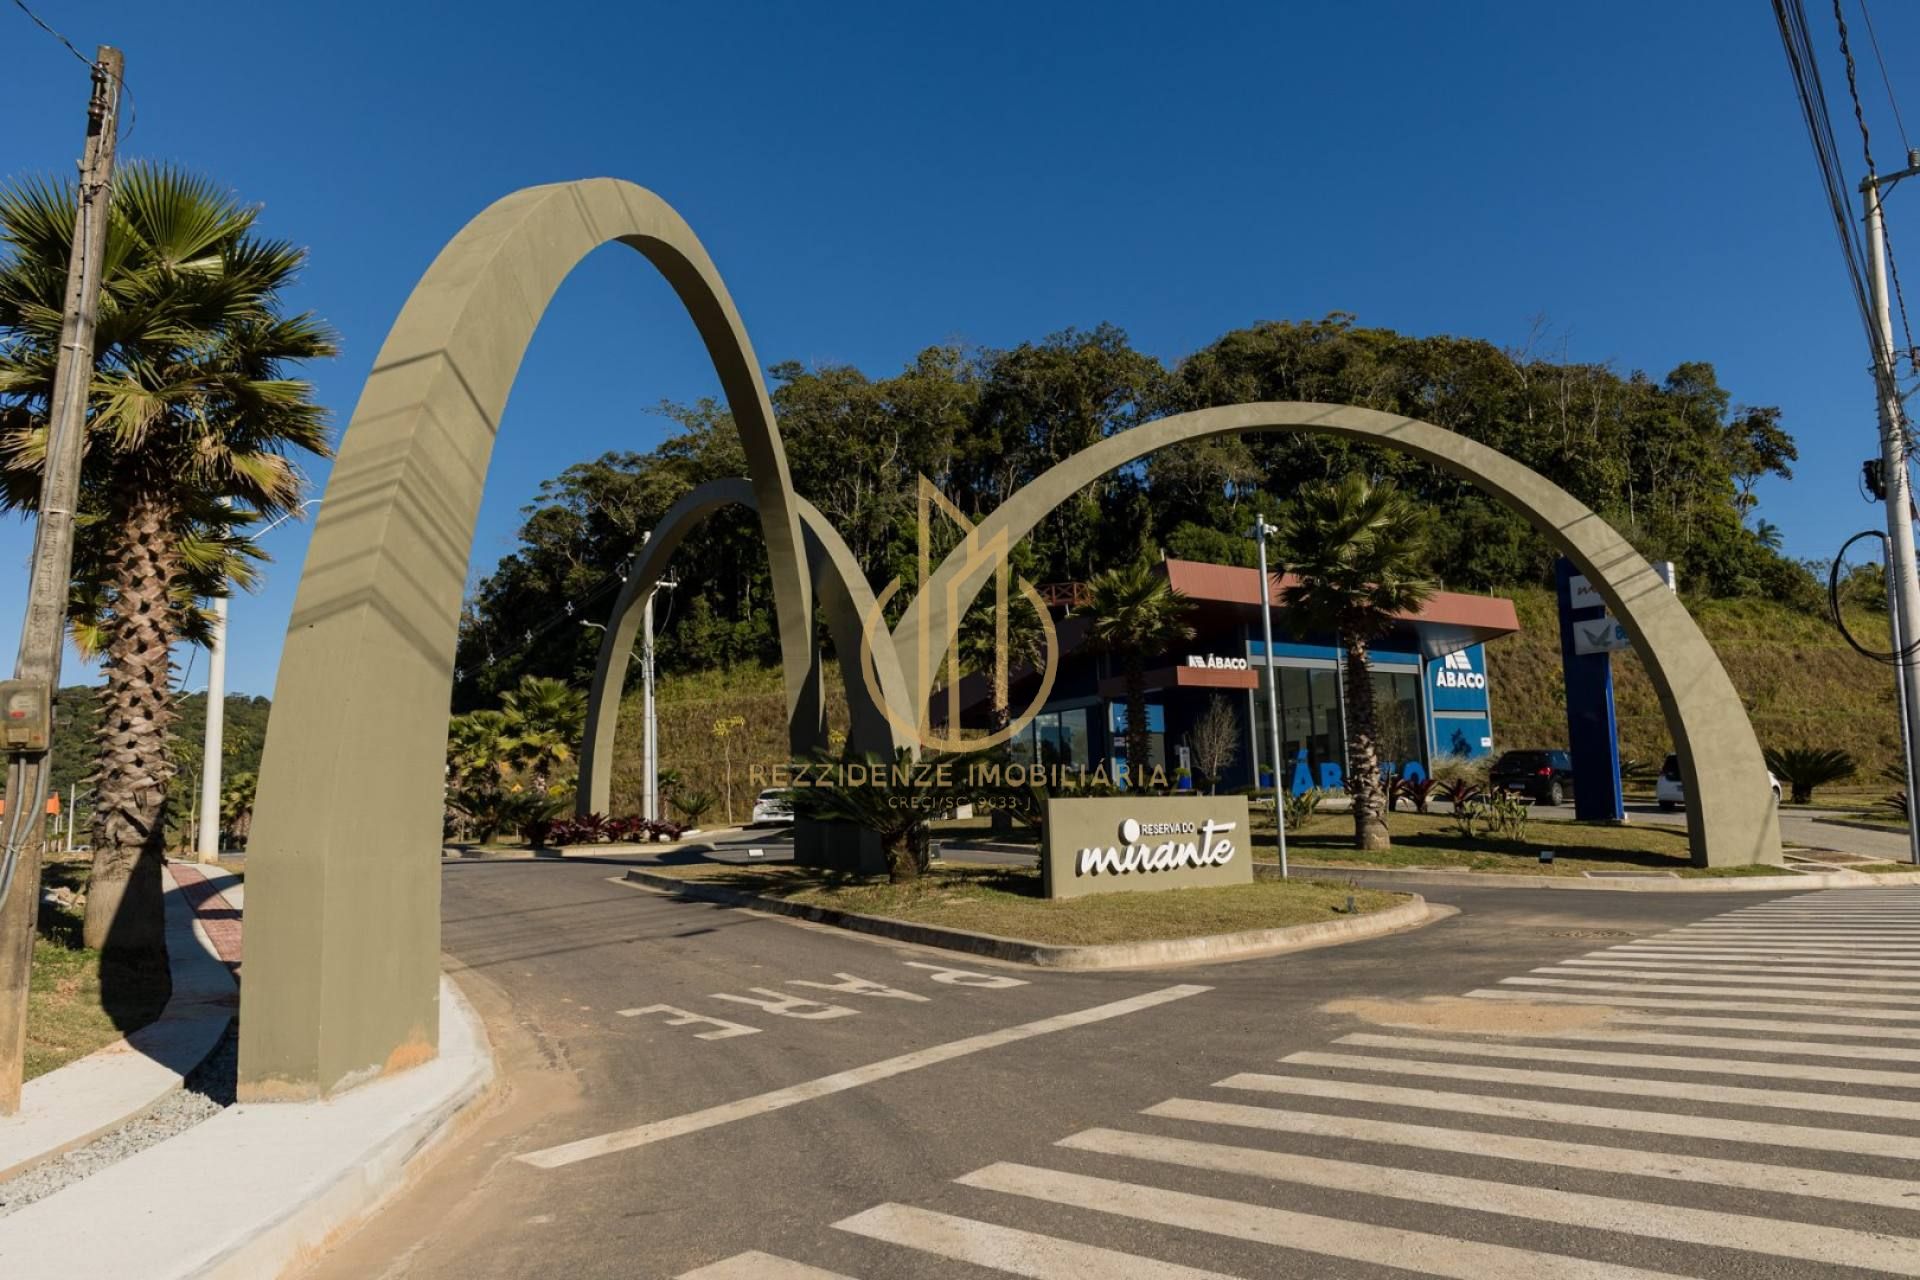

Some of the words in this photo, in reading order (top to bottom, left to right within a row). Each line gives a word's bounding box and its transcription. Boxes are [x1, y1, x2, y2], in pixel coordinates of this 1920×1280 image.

[1207, 653, 1247, 670] ÁBACO
[1436, 667, 1485, 689] ÁBACO
[1142, 823, 1180, 835] RESERVA
[1183, 822, 1195, 833] DO
[1081, 818, 1236, 874] mirante
[615, 961, 1033, 1041] PARE
